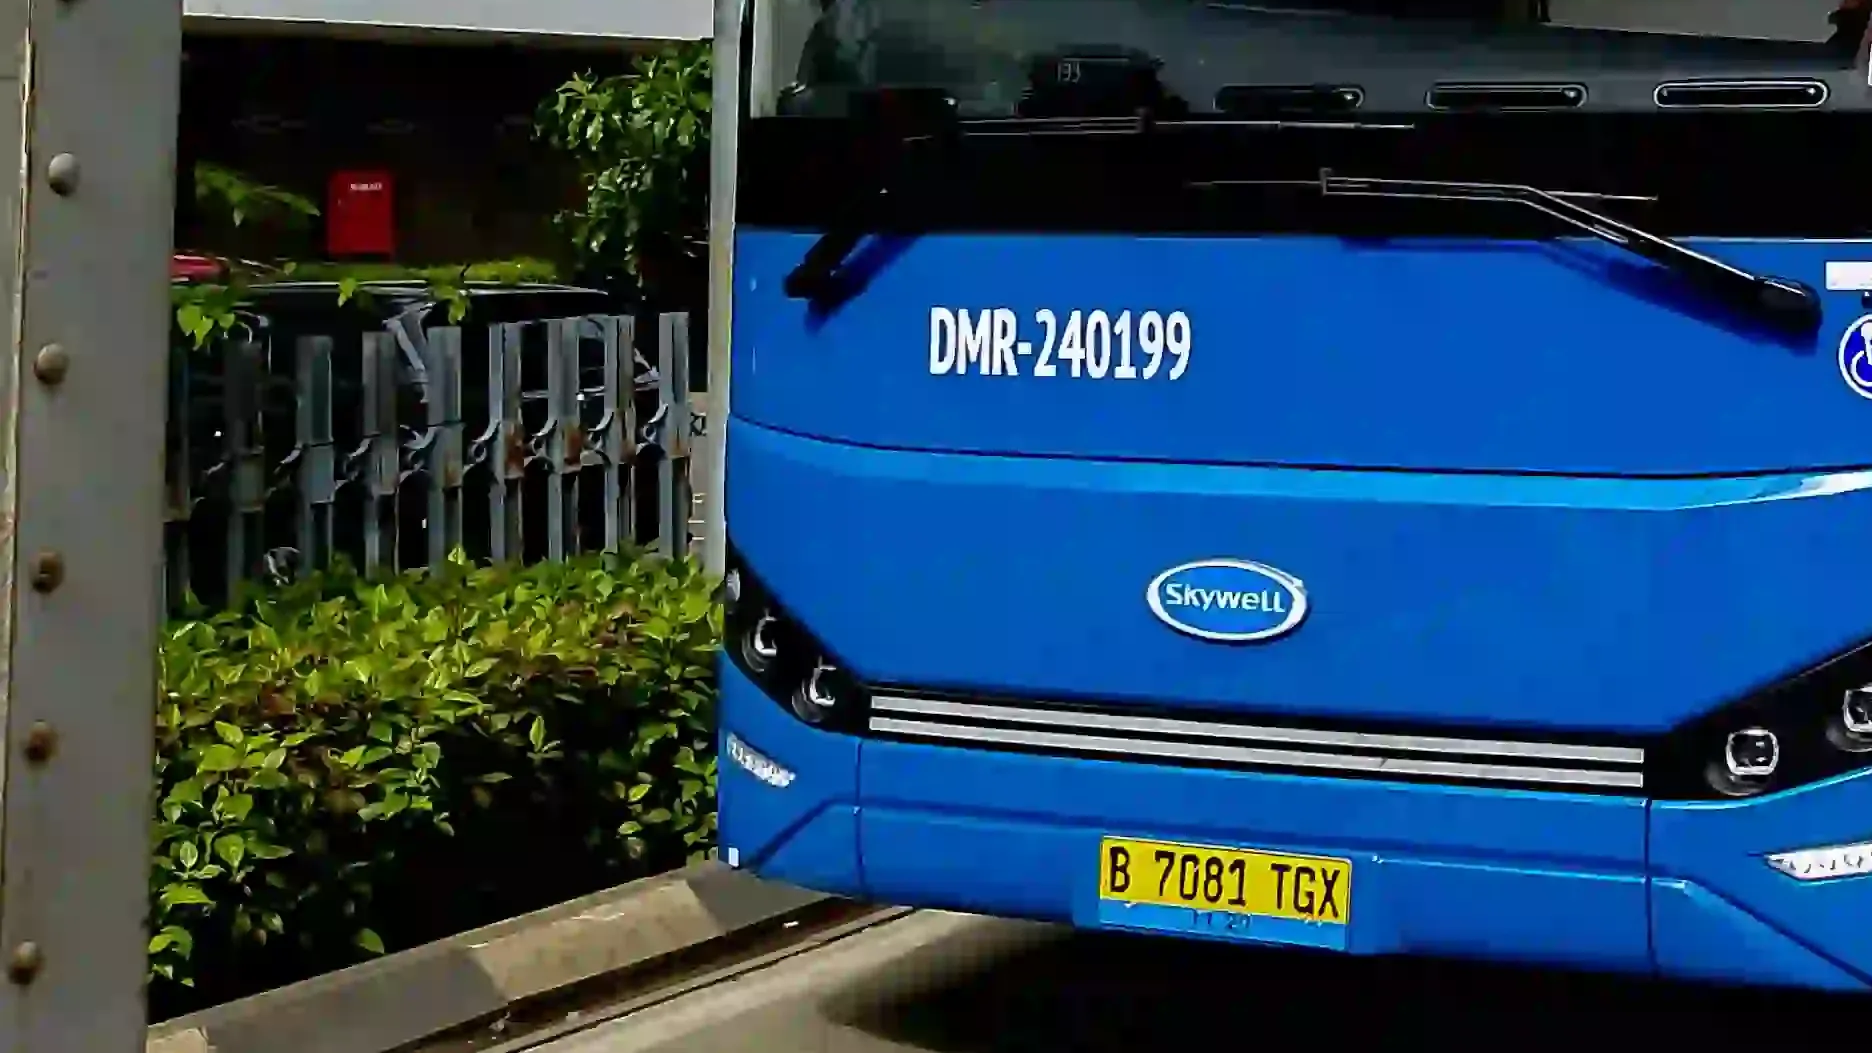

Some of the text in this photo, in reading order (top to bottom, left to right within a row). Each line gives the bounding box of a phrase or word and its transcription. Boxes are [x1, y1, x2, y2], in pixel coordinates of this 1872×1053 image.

[928, 306, 1192, 381] DMR-240199
[1109, 846, 1342, 919] B 7081 TGX
